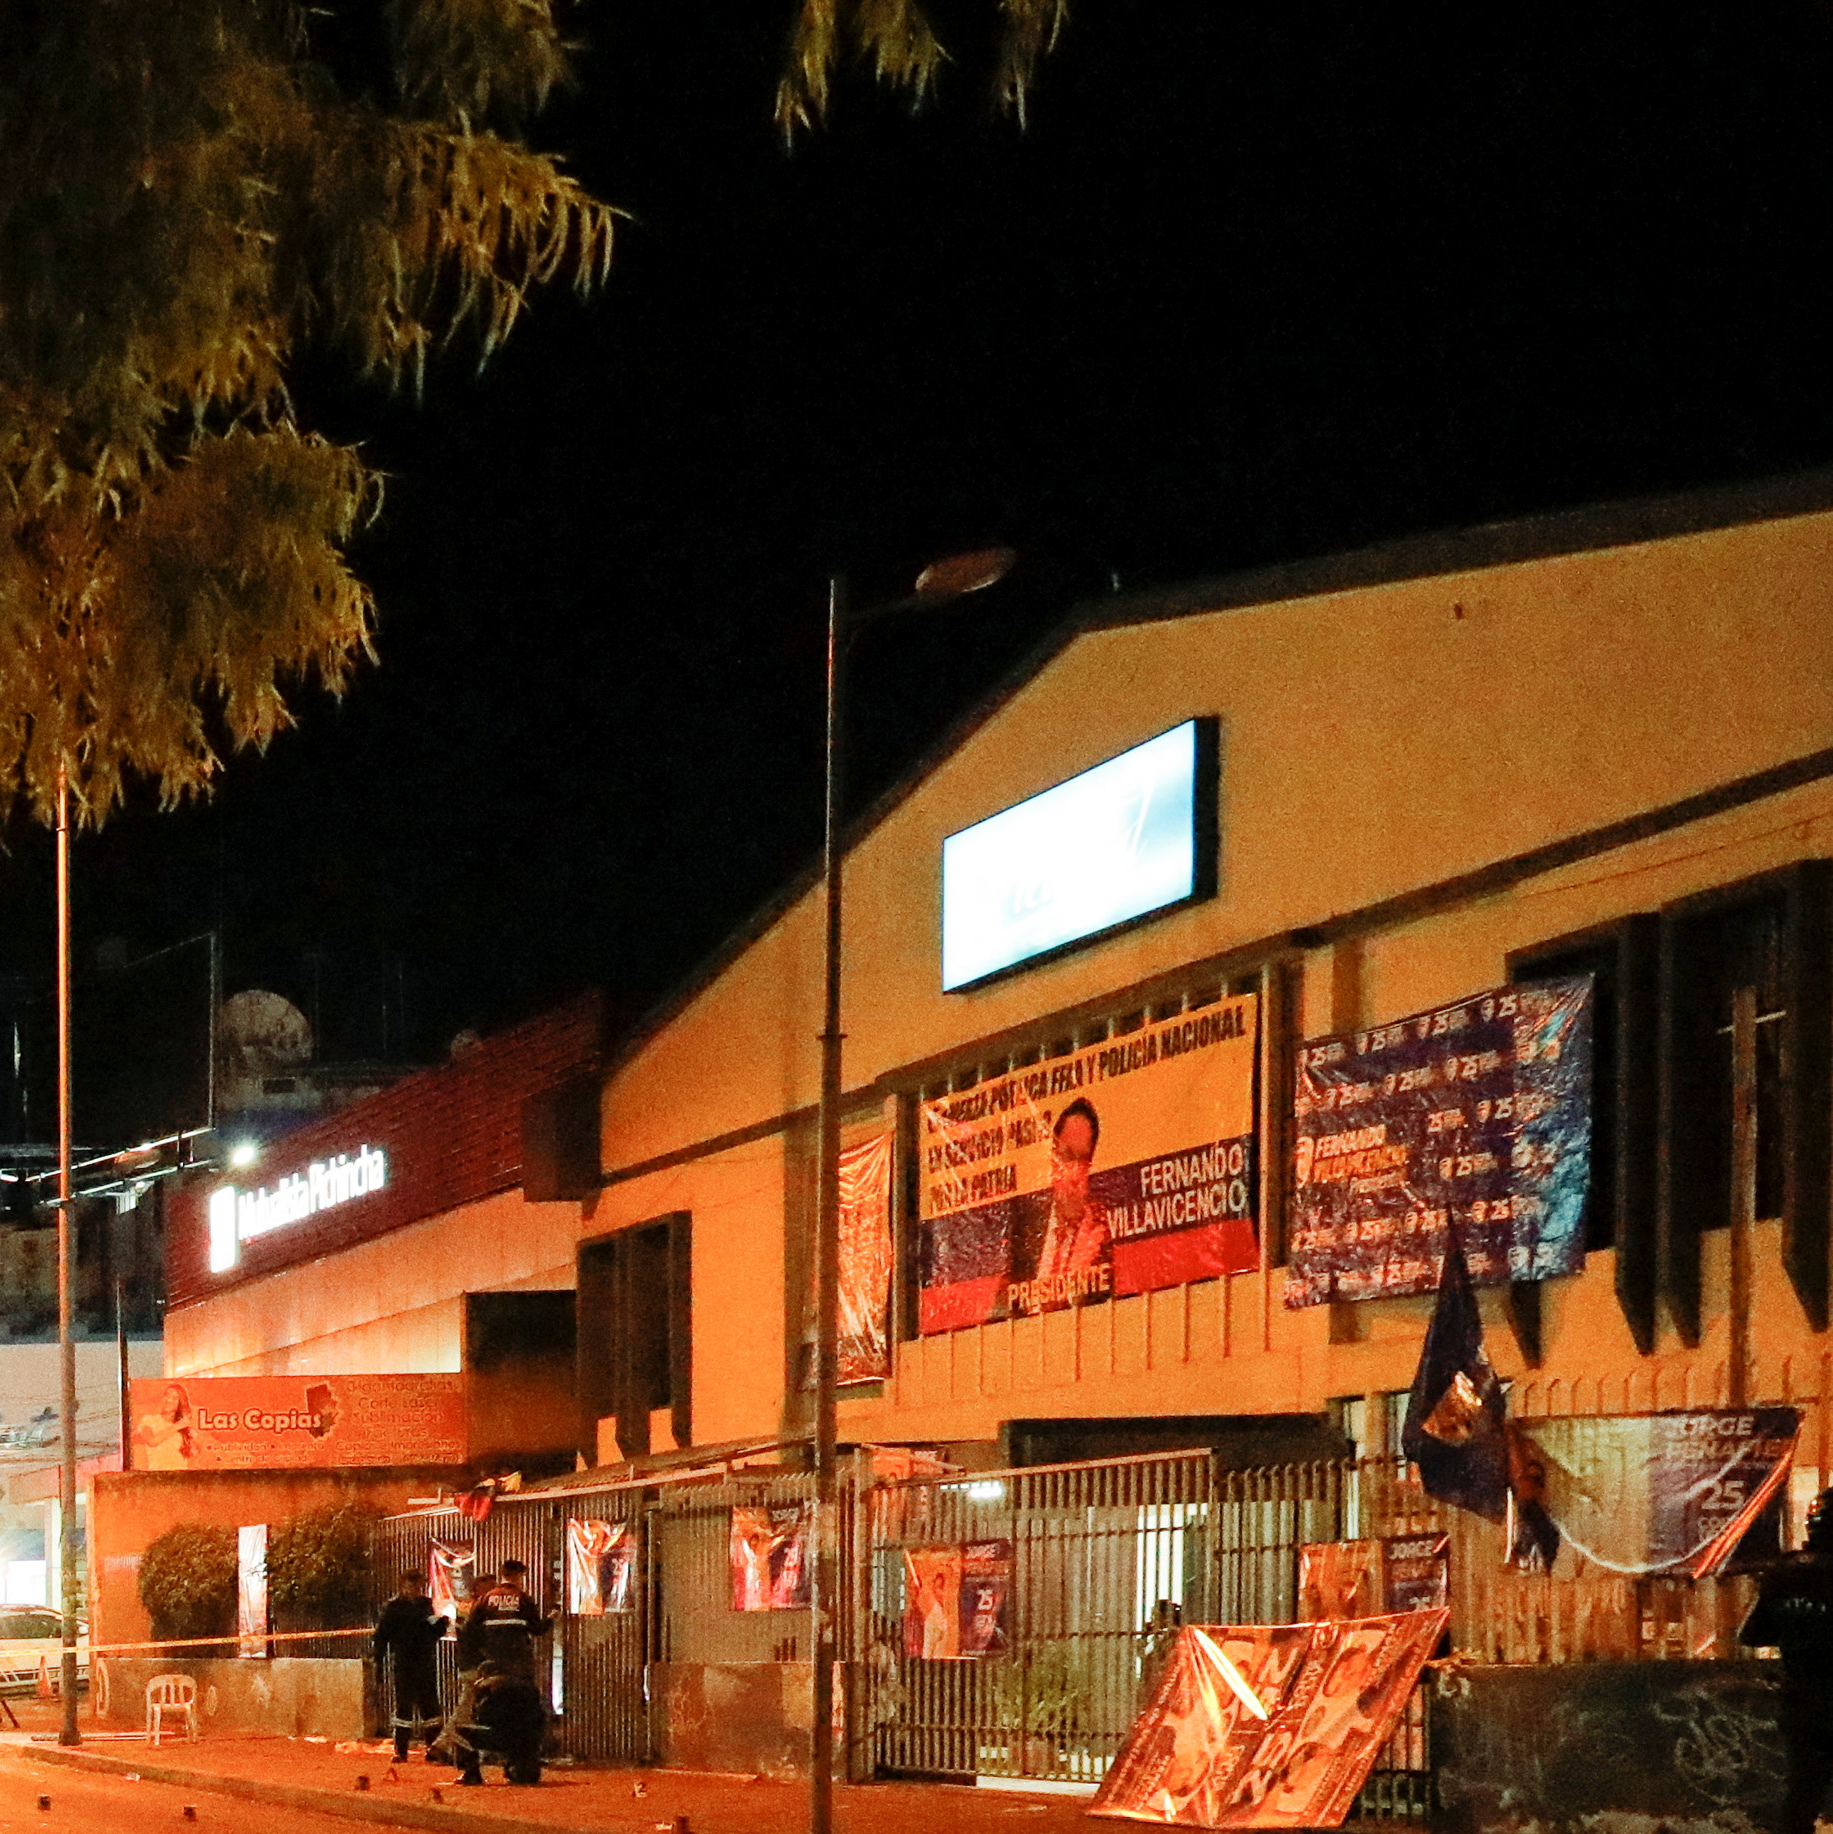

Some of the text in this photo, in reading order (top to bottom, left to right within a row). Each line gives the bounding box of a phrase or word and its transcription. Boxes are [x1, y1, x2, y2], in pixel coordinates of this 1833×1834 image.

[1139, 1142, 1245, 1198] FERNANDO
[1106, 1180, 1248, 1239] VILLAVICENCIO
[1008, 1262, 1111, 1313] PRESIDENTE
[198, 1407, 323, 1435] Las Copias
[1701, 1480, 1746, 1511] 25
[1387, 1539, 1433, 1560] JORGE
